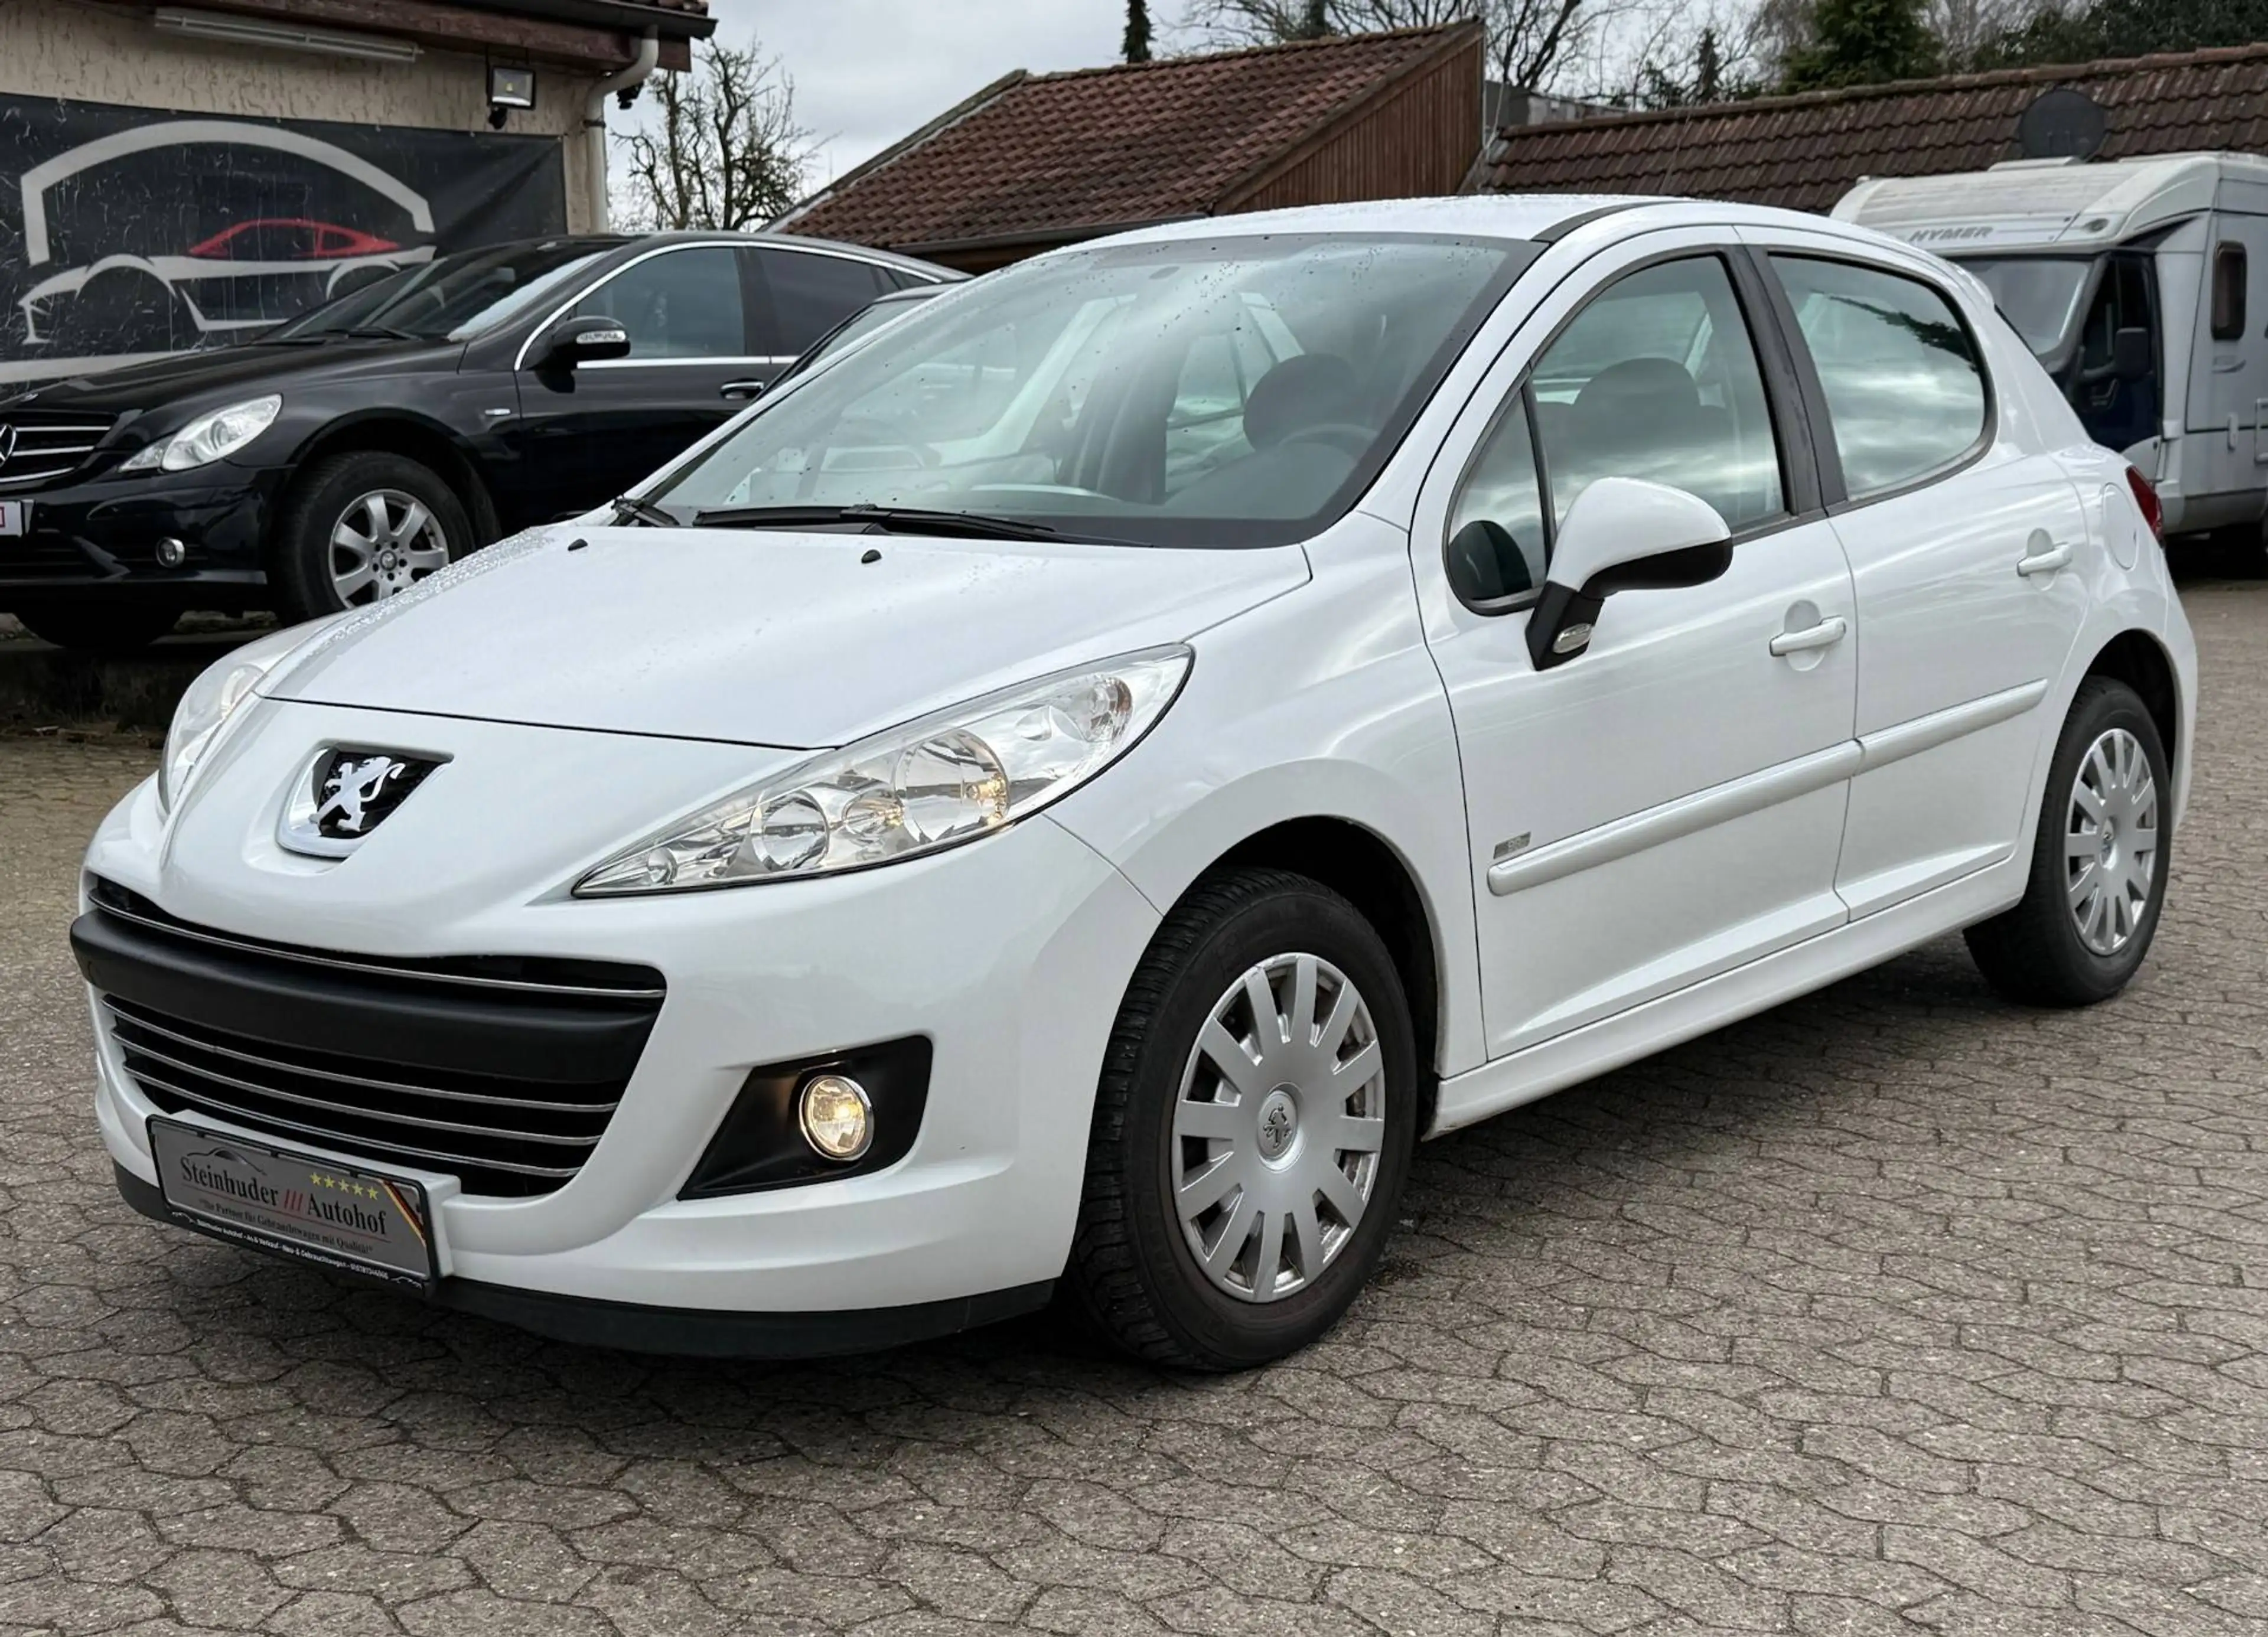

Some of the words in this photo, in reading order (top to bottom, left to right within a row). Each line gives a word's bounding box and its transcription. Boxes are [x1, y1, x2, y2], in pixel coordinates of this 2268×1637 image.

[1908, 226, 1993, 242] HYMER
[180, 1157, 278, 1206] Steinhuder
[307, 1193, 387, 1235] Autohof
